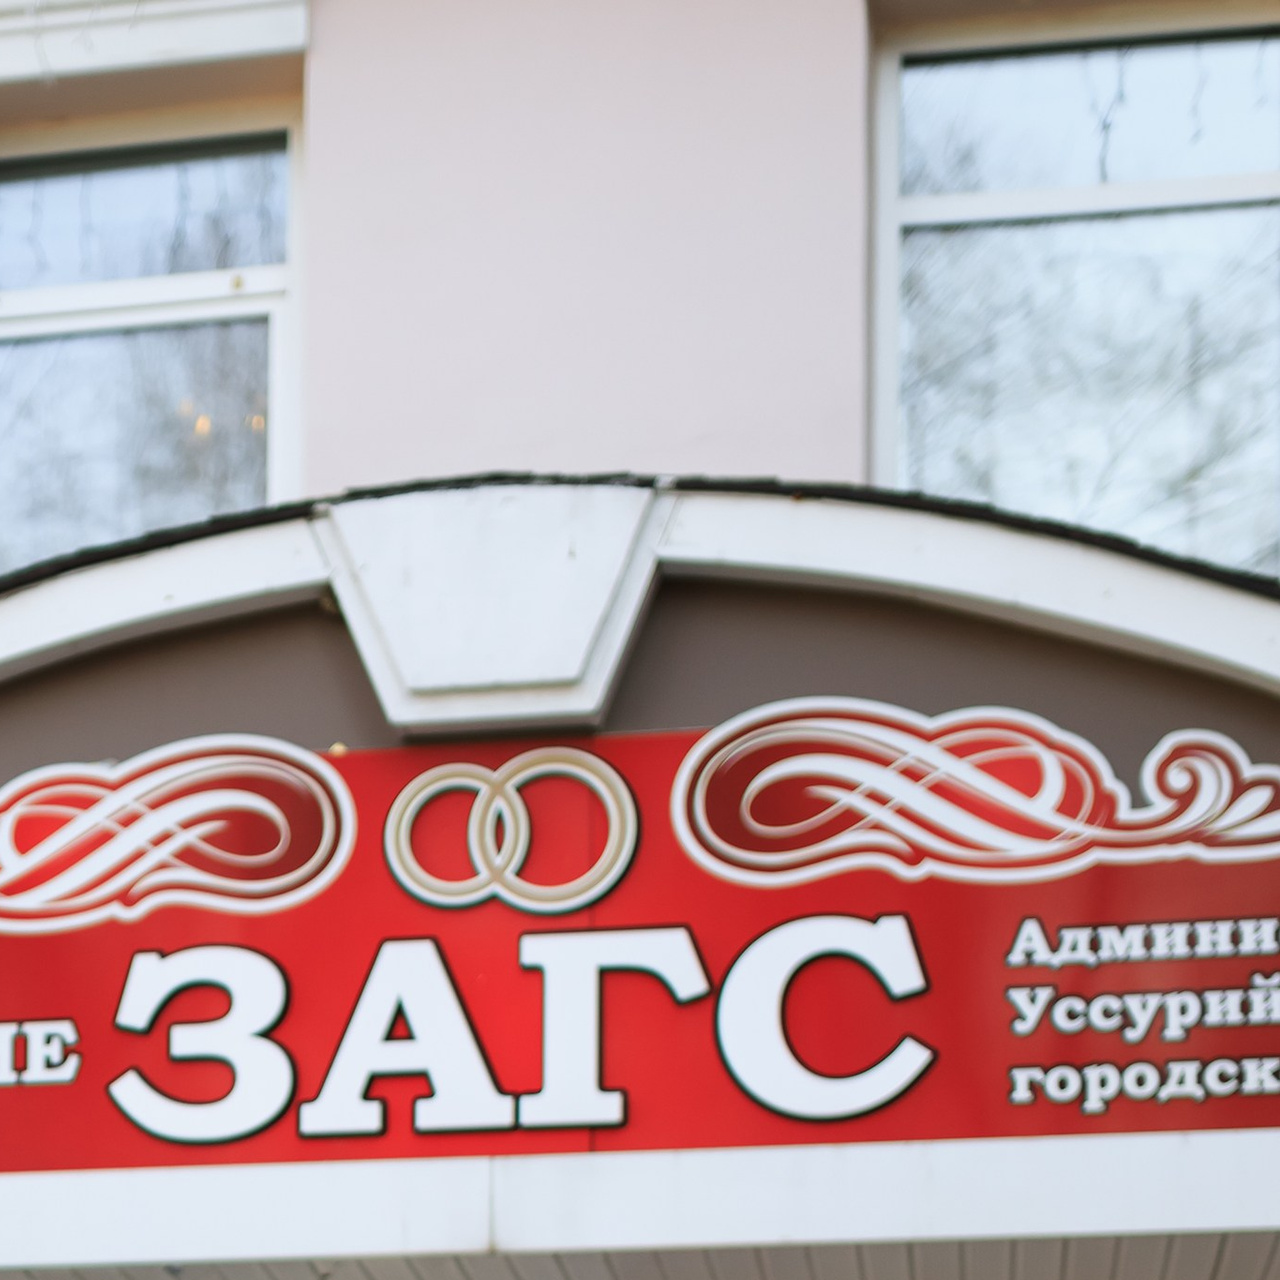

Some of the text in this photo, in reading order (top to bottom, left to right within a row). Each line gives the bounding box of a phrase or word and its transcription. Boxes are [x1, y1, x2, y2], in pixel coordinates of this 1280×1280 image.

[1005, 917, 1279, 969] Админи
[107, 914, 933, 1143] ЗАГС
[1006, 972, 1280, 1043] Уссурий
[1009, 1056, 1280, 1114] городск
